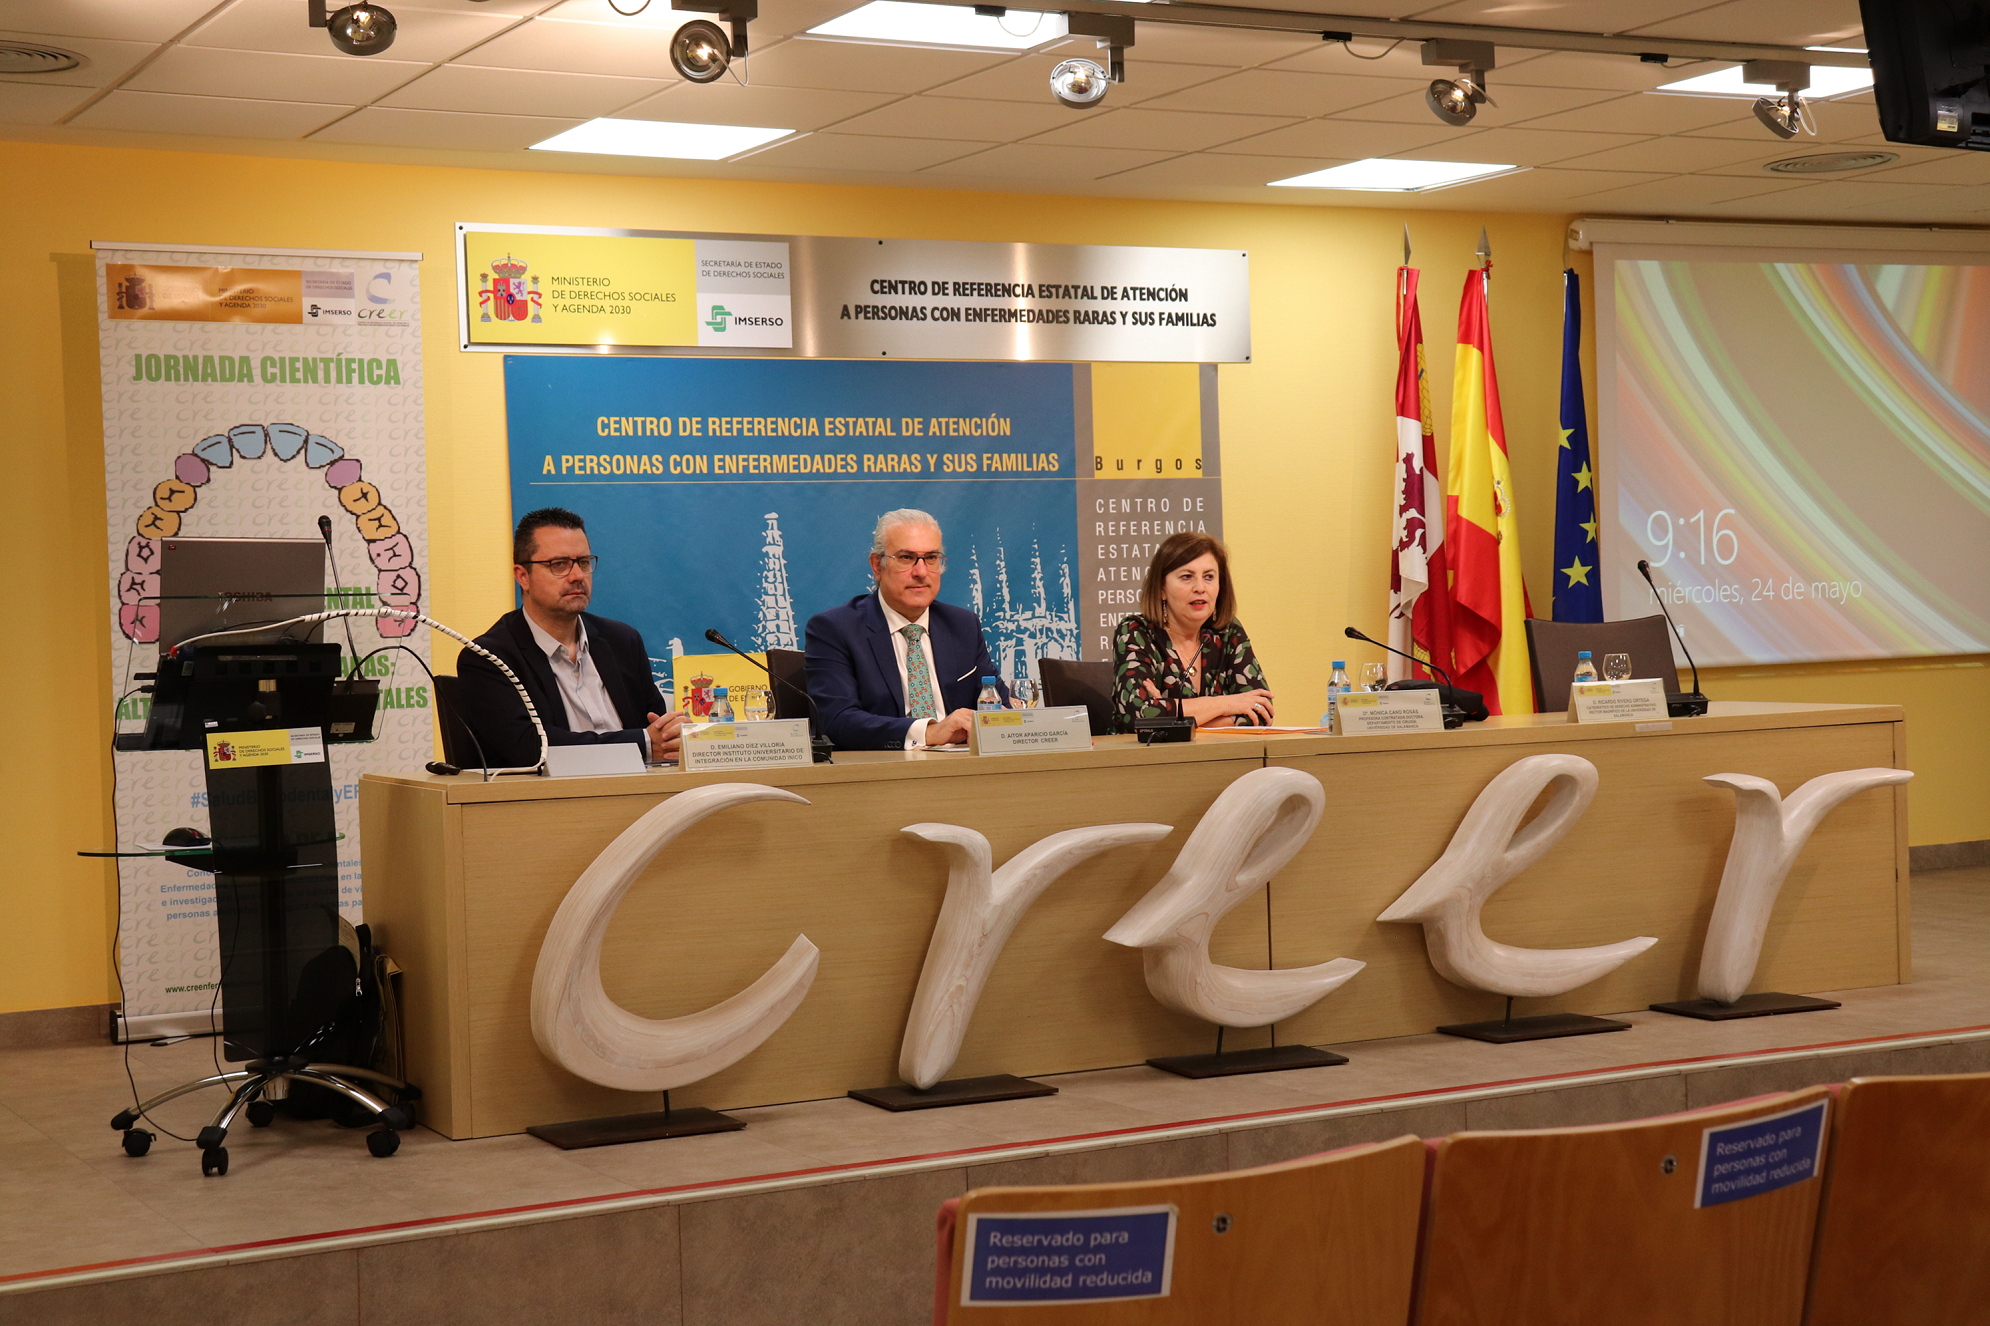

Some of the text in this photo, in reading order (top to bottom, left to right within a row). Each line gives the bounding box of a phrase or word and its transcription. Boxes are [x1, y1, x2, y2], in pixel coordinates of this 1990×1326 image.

[701, 259, 783, 270] SECRETARÍA DE ESTADO
[551, 276, 611, 288] MINISTERIO
[702, 270, 785, 279] DE DERECHOS SOCIALES
[552, 290, 677, 303] DE DERECHOS SOCIALES
[870, 278, 1189, 303] CENTRO DE REFERENCIA ESTATAL DE ATENCIÓN
[357, 308, 409, 320] creer
[552, 303, 632, 315] Y AGENDA 2030
[840, 304, 1218, 328] A PERSONAS CON ENFERMEDADES RARAS Y SUS FAMILIAS
[734, 317, 784, 327] IMSERSO
[132, 352, 402, 386] JORNADA CIENTÍFICA
[596, 412, 1011, 438] CENTRO DE REFERENCIA ESTATAL DE ATENCIÓN
[542, 452, 1060, 475] A PERSONAS CON ENFERMEDADES RARAS Y SUS FAMILIAS
[1094, 455, 1203, 474] Burgos
[1096, 497, 1205, 514] CENTRO DE
[1095, 520, 1206, 536] REFERENCIA
[1646, 508, 1739, 568] 9:16
[1649, 576, 1863, 605] miércoles, 24 de mayo
[728, 684, 768, 693] GOBIERNO
[695, 756, 734, 764] INTEGRACIÓN
[341, 873, 351, 881] en
[341, 886, 352, 894] de
[166, 911, 211, 922] personas
[1716, 1126, 1802, 1156] Reservado para
[1713, 1148, 1788, 1178] personas con
[1711, 1157, 1812, 1194] movilidad reducida
[989, 1230, 1130, 1248] Reservado para
[987, 1252, 1106, 1271] personas con
[985, 1269, 1153, 1290] movilidad reducida
